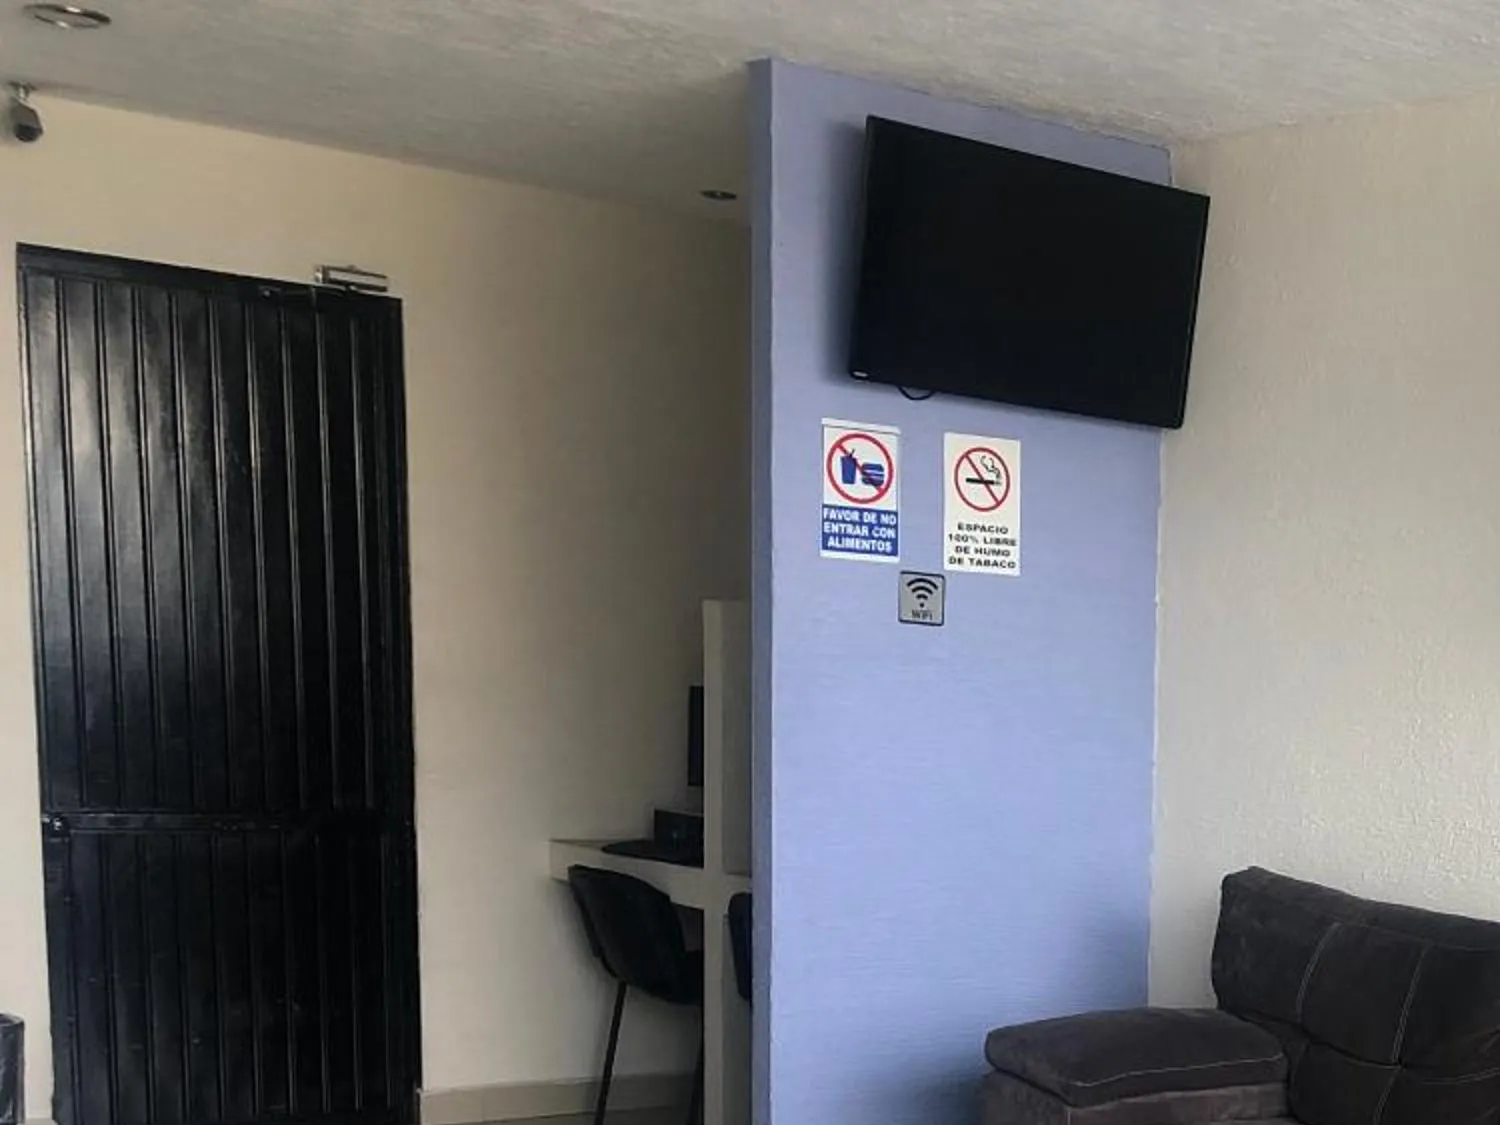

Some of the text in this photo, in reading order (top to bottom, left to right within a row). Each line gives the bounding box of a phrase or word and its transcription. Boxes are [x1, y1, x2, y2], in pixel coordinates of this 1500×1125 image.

[823, 507, 897, 525] FAVOR DE NO
[823, 521, 896, 539] ENTRAR CON
[957, 522, 1009, 534] ESPACIO
[827, 535, 893, 553] ALIMENTOS
[948, 533, 1016, 546] 100% LIBRE
[955, 546, 1011, 557] DE HUMO
[949, 556, 1016, 568] DE TABACO
